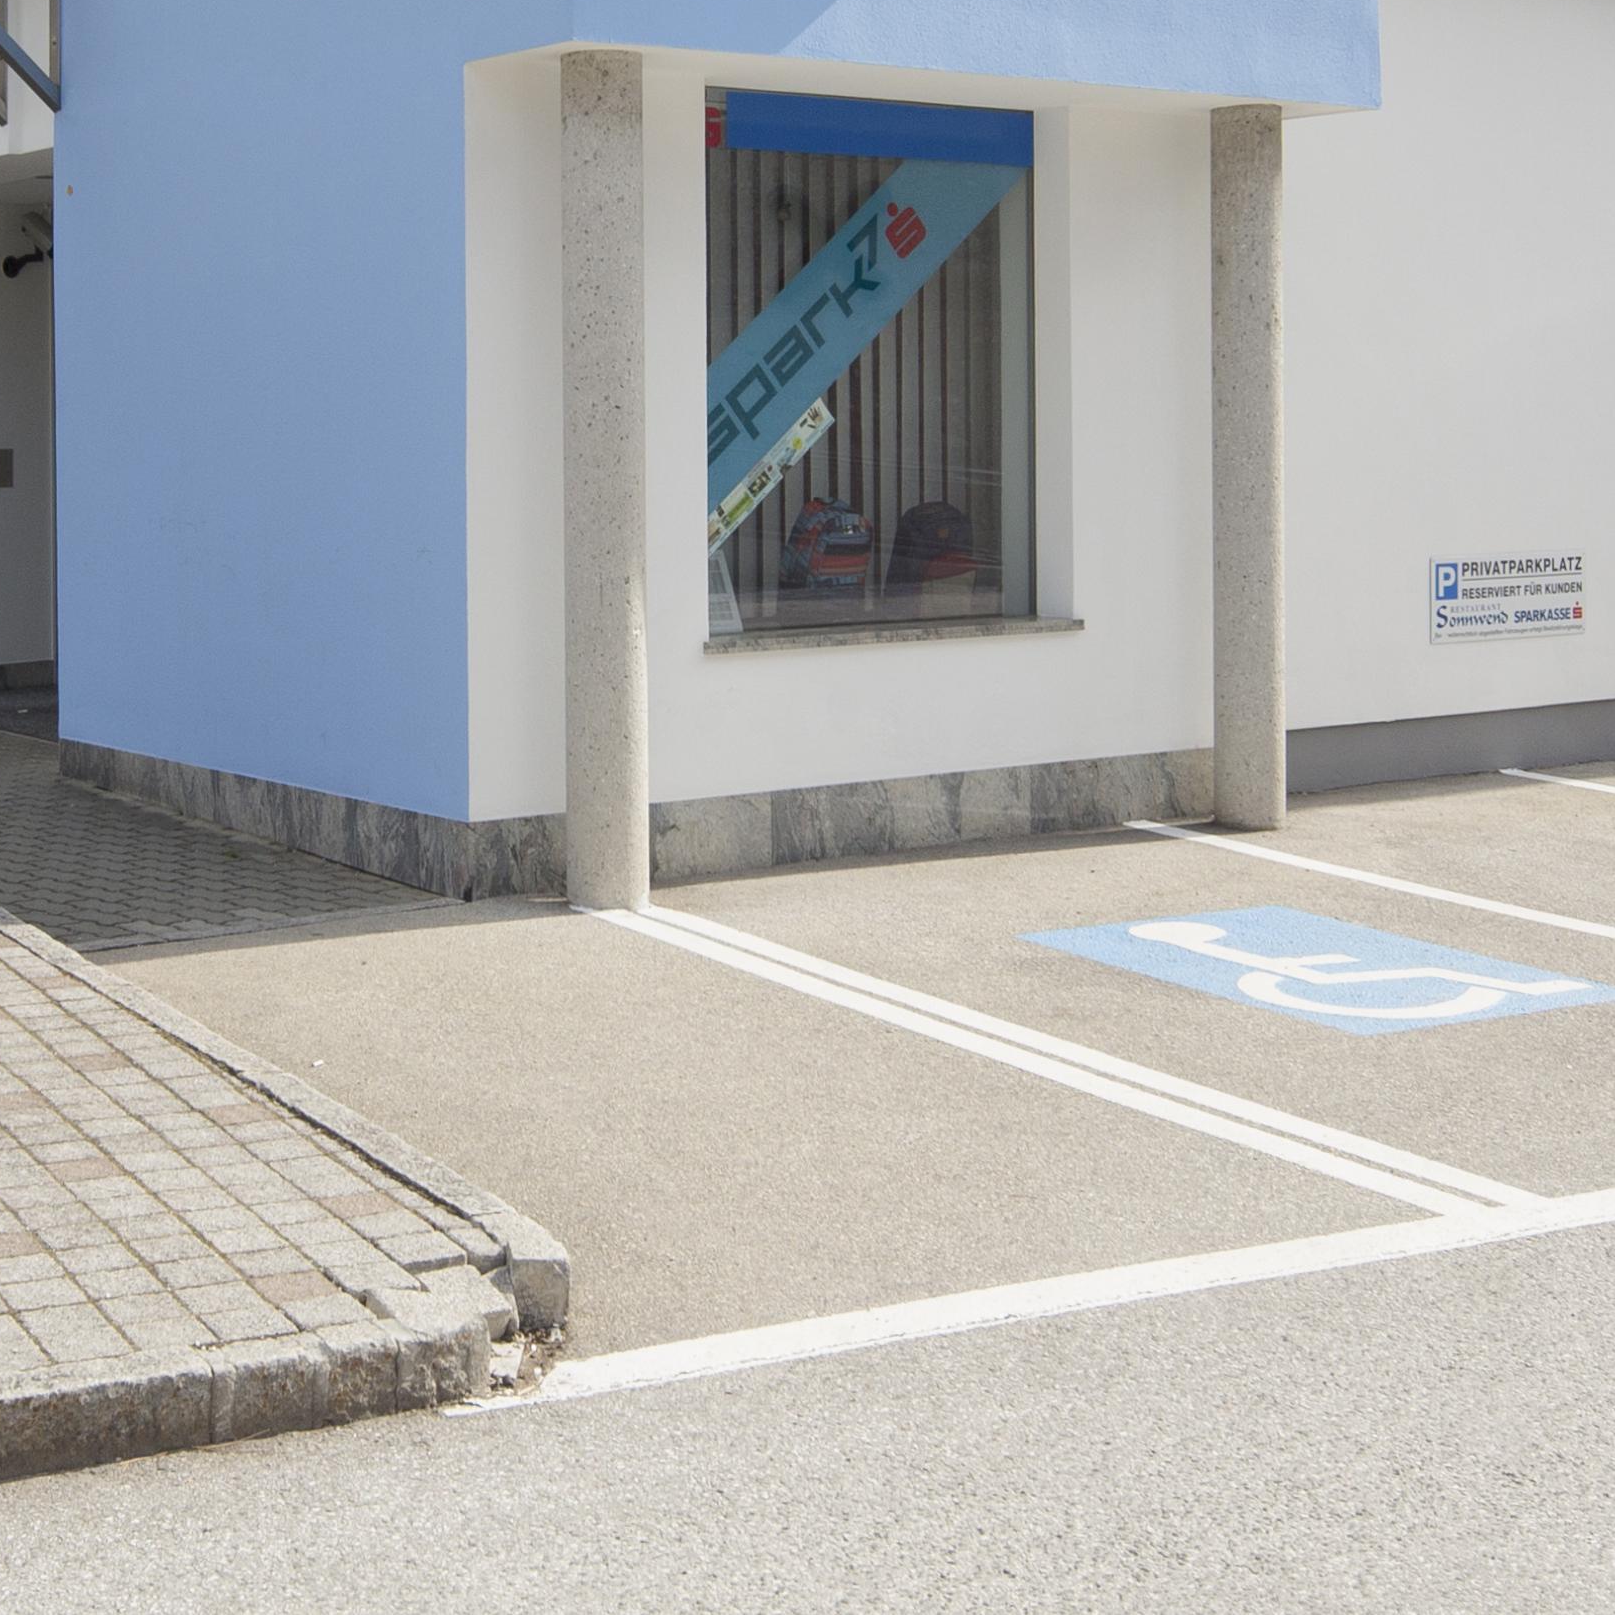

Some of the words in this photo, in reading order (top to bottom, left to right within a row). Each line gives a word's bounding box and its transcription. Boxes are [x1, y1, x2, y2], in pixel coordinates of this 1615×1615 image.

[1461, 557, 1582, 577] PRIVATPARKPLATZ
[1462, 585, 1522, 600] RESERVIERT
[1524, 582, 1542, 596] FÜR
[1545, 582, 1583, 594] KUNDEN
[1436, 605, 1508, 628] Sonnwend
[1450, 603, 1501, 613] RESTAURANT
[1514, 607, 1571, 623] SPARKASSE
